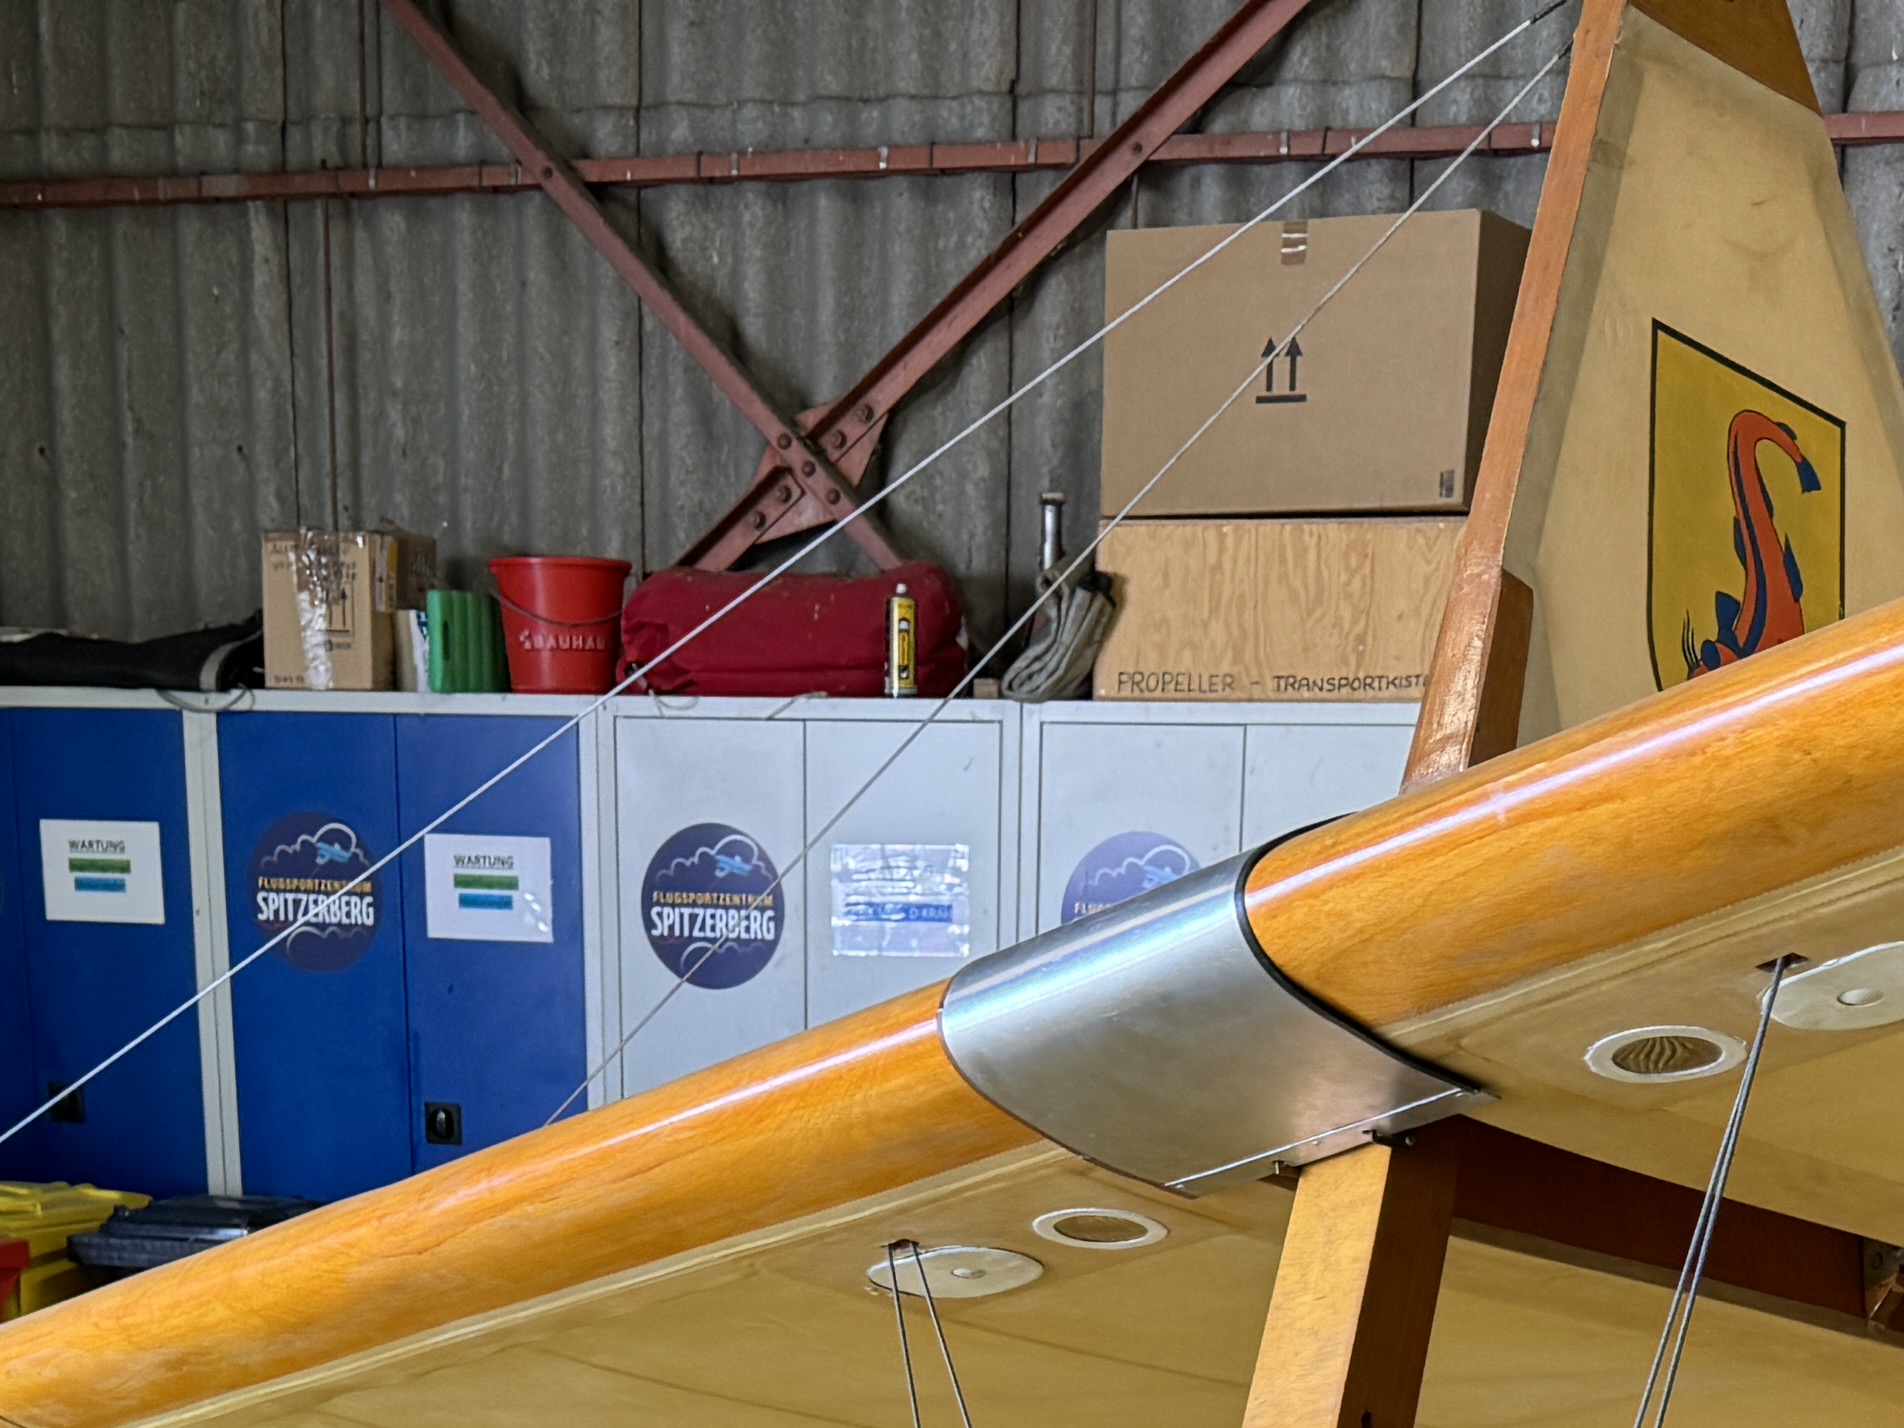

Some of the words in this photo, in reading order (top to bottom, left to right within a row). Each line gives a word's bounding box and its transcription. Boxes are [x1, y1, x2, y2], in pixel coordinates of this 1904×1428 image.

[533, 633, 613, 650] BAUHAU
[1117, 671, 1235, 694] PROPELLER
[454, 854, 513, 868] WARTUNG
[256, 891, 375, 926] SPITZERBERG
[650, 906, 775, 941] SPITZERBERG
